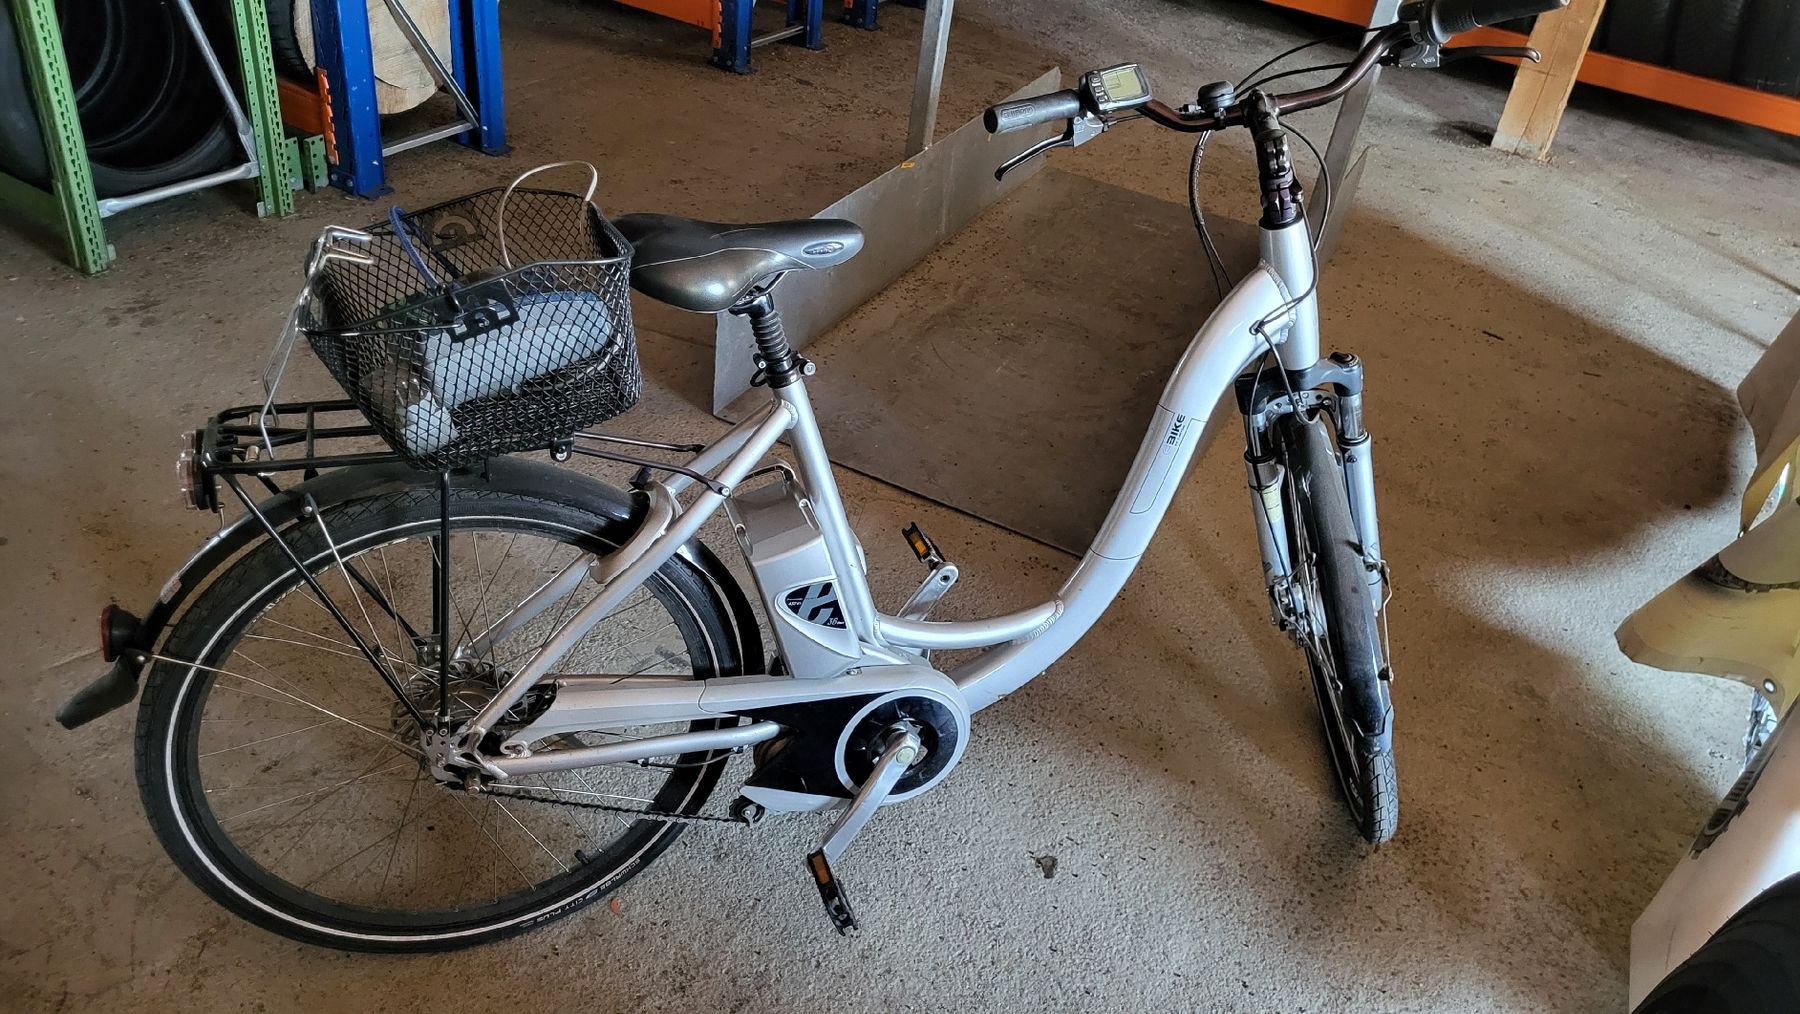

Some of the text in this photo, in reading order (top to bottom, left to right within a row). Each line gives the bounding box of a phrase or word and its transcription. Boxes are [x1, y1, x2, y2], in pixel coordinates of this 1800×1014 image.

[536, 857, 641, 923] SCHWALBE CITY PLUS
